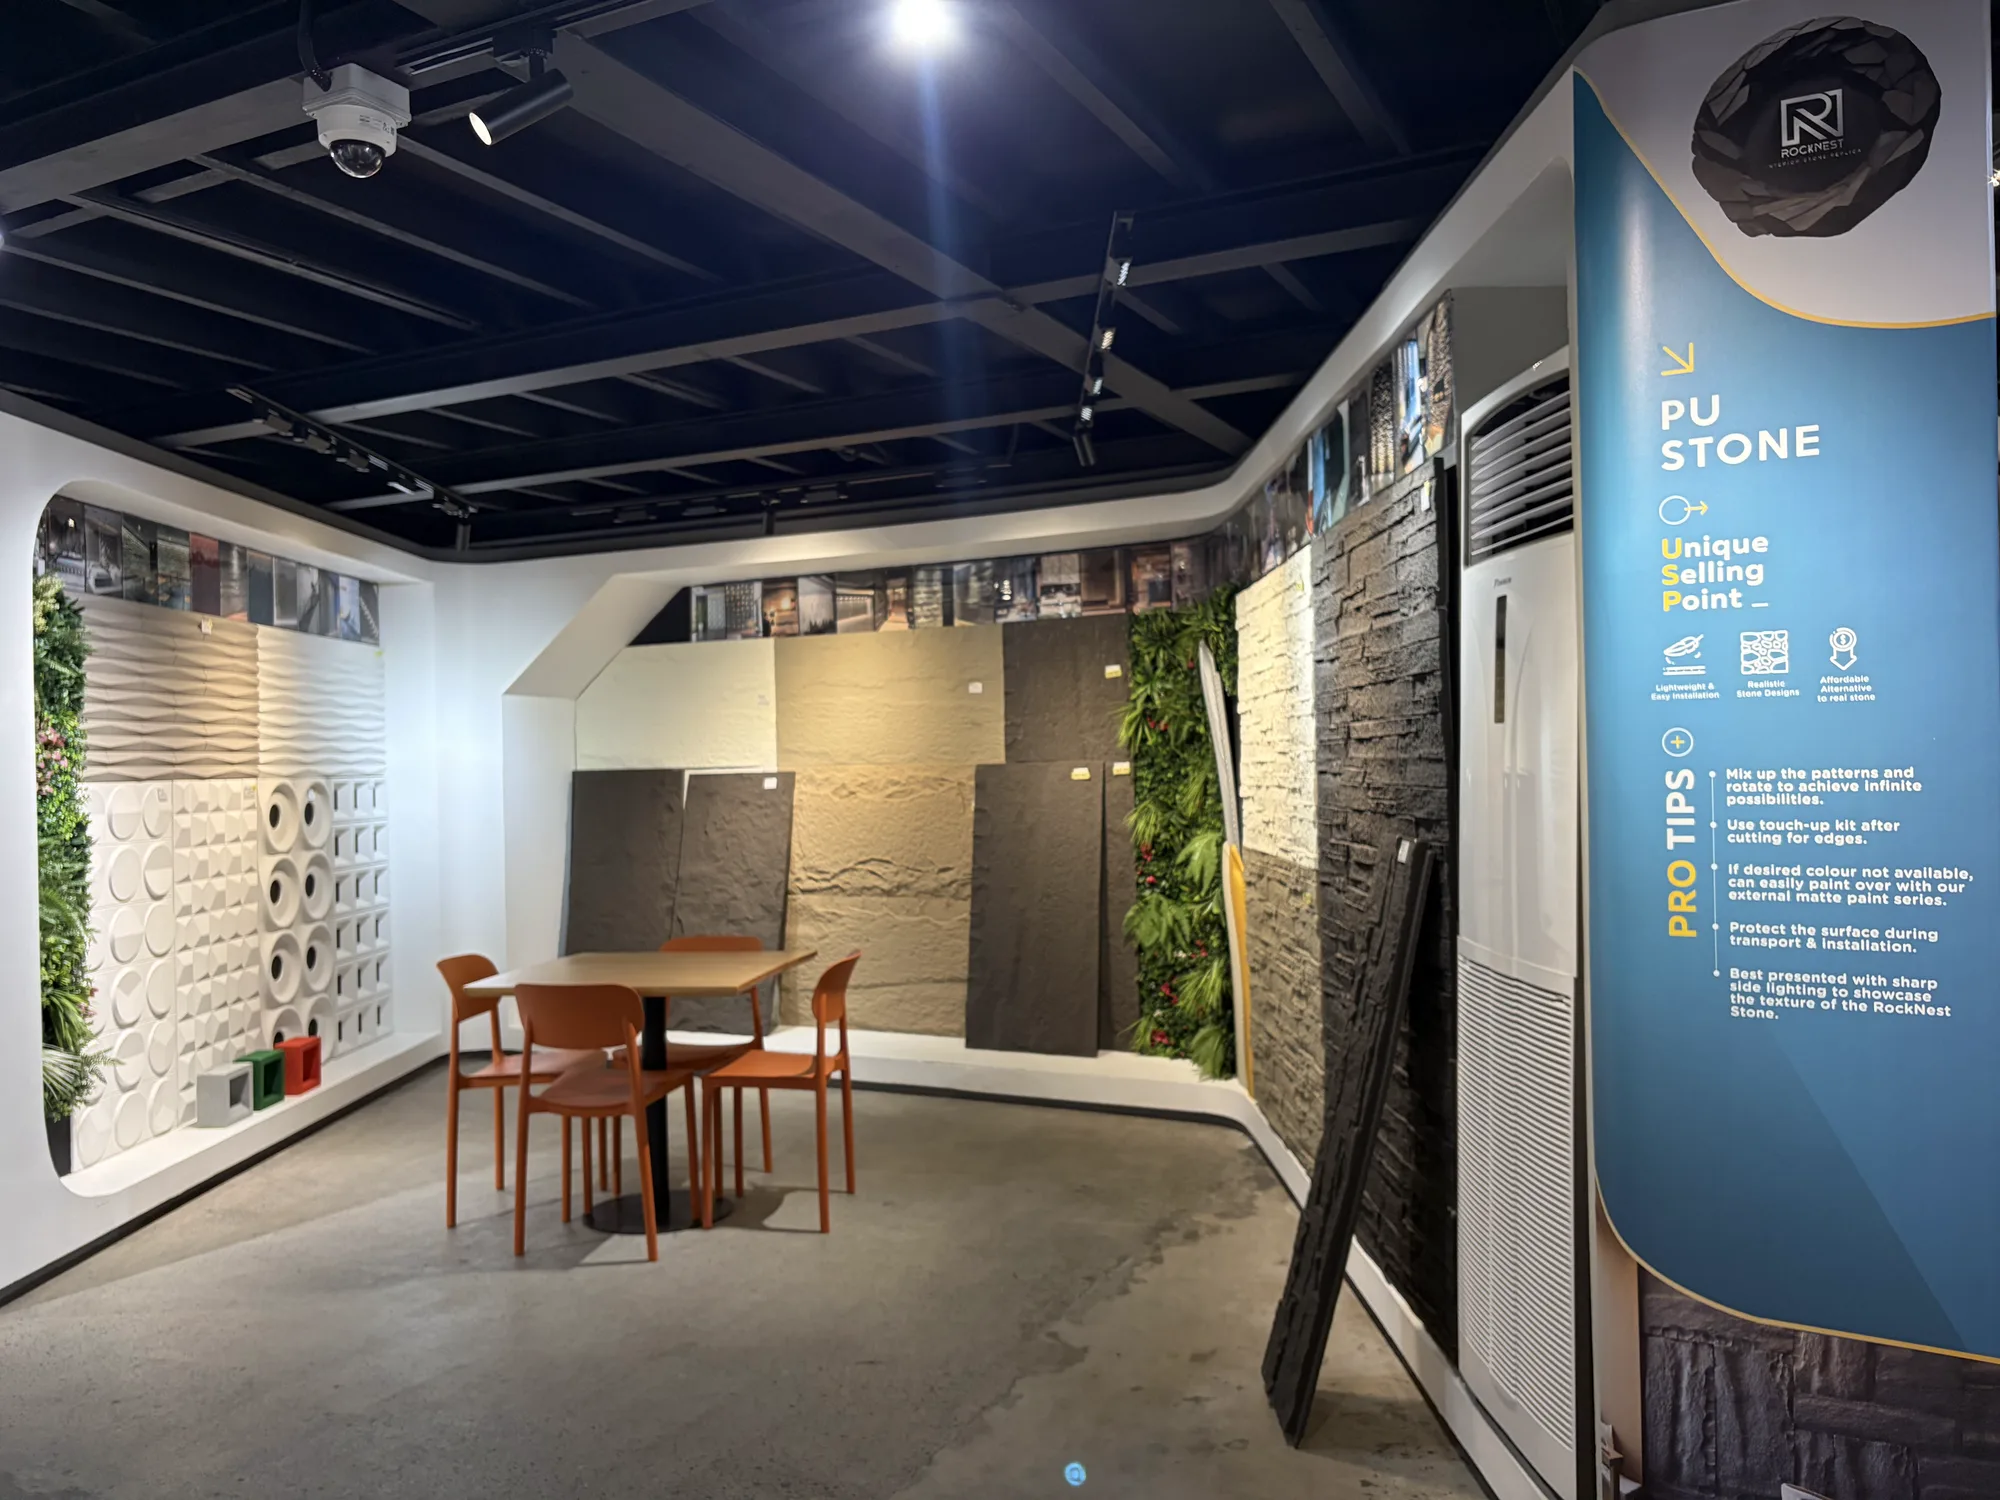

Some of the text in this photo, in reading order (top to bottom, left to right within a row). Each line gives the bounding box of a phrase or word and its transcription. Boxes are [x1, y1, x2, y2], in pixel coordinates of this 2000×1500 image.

[1781, 139, 1844, 158] ROCKNEST
[1661, 394, 1720, 431] PU
[1661, 424, 1820, 471] STONE
[1661, 535, 1768, 559] Unique
[1661, 562, 1764, 586] Selling
[1662, 588, 1742, 611] Point
[1820, 675, 1869, 684] Affordable
[1651, 691, 1719, 701] Easy Installation
[1656, 684, 1705, 692] Lightweight
[1737, 689, 1799, 698] Stone Designs
[1821, 684, 1872, 693] Alternative
[1830, 694, 1847, 702] real
[1850, 693, 1875, 701] stone
[1726, 766, 1913, 782] Mix up the patterns and
[1726, 780, 1921, 793] rotate to achieve infinite
[1726, 794, 1824, 807] possibilities.
[1728, 819, 1900, 832] Use touch-up kit after
[1727, 832, 1868, 846] cutting for edges.
[1666, 769, 1697, 938] PRO TIPS
[1729, 864, 1973, 882] If desired colour not available,
[1728, 878, 1965, 893] can easily paint over with our
[1728, 891, 1947, 906] external matte paint series.
[1730, 922, 1938, 942] Protect the surface during
[1730, 935, 1916, 952] transport & installation.
[1730, 969, 1938, 991] Best presented with sharp
[1730, 981, 1931, 1002] side lighting to showcase
[1730, 994, 1951, 1017] the texture of the RockNest
[1730, 1006, 1779, 1019] Stone.
